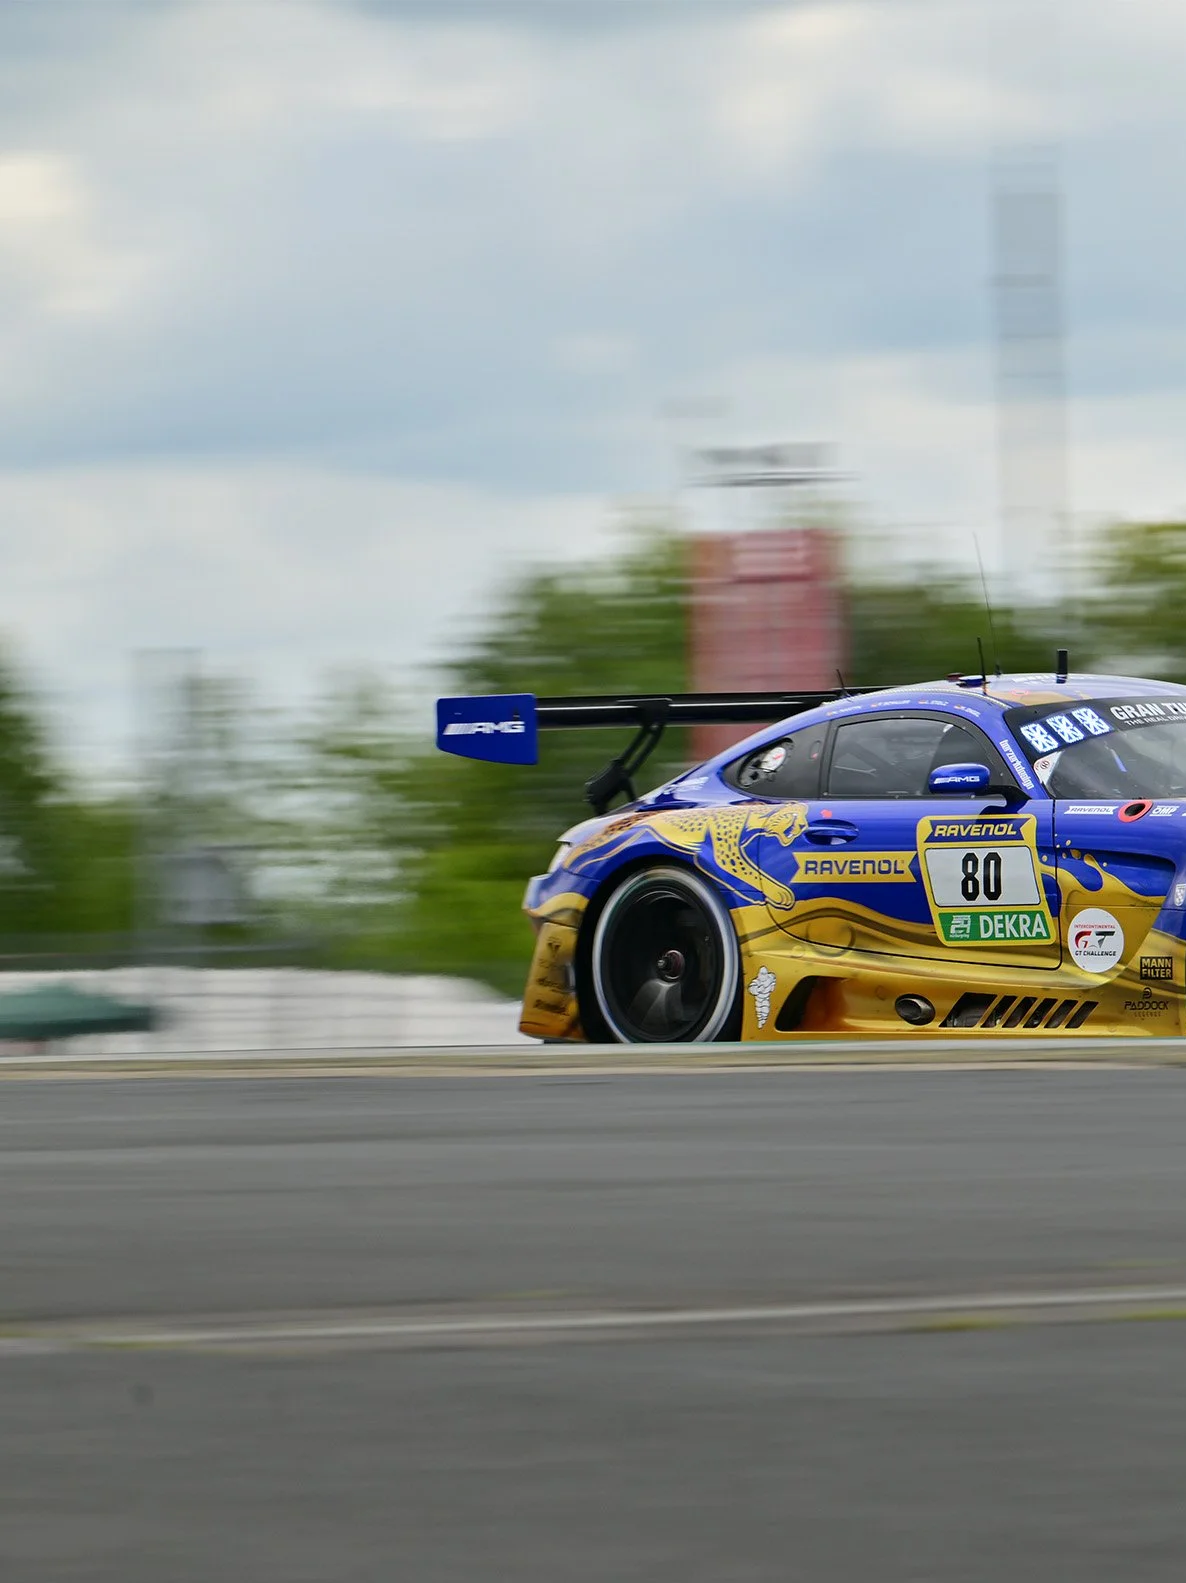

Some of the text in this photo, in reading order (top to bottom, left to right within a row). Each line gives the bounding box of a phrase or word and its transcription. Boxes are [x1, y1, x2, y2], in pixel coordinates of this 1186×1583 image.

[1110, 702, 1166, 721] GRAN
[1124, 718, 1145, 727] THE
[1144, 715, 1168, 725] REAL
[949, 775, 980, 783] AMG
[934, 823, 1017, 837] RAVENOL
[804, 859, 905, 875] RAVENOL
[961, 852, 1002, 902] 80
[979, 913, 1048, 939] DEKRA
[1142, 958, 1172, 968] MANN
[1142, 968, 1172, 978] FILTER
[1124, 1001, 1168, 1011] PADDOCK
